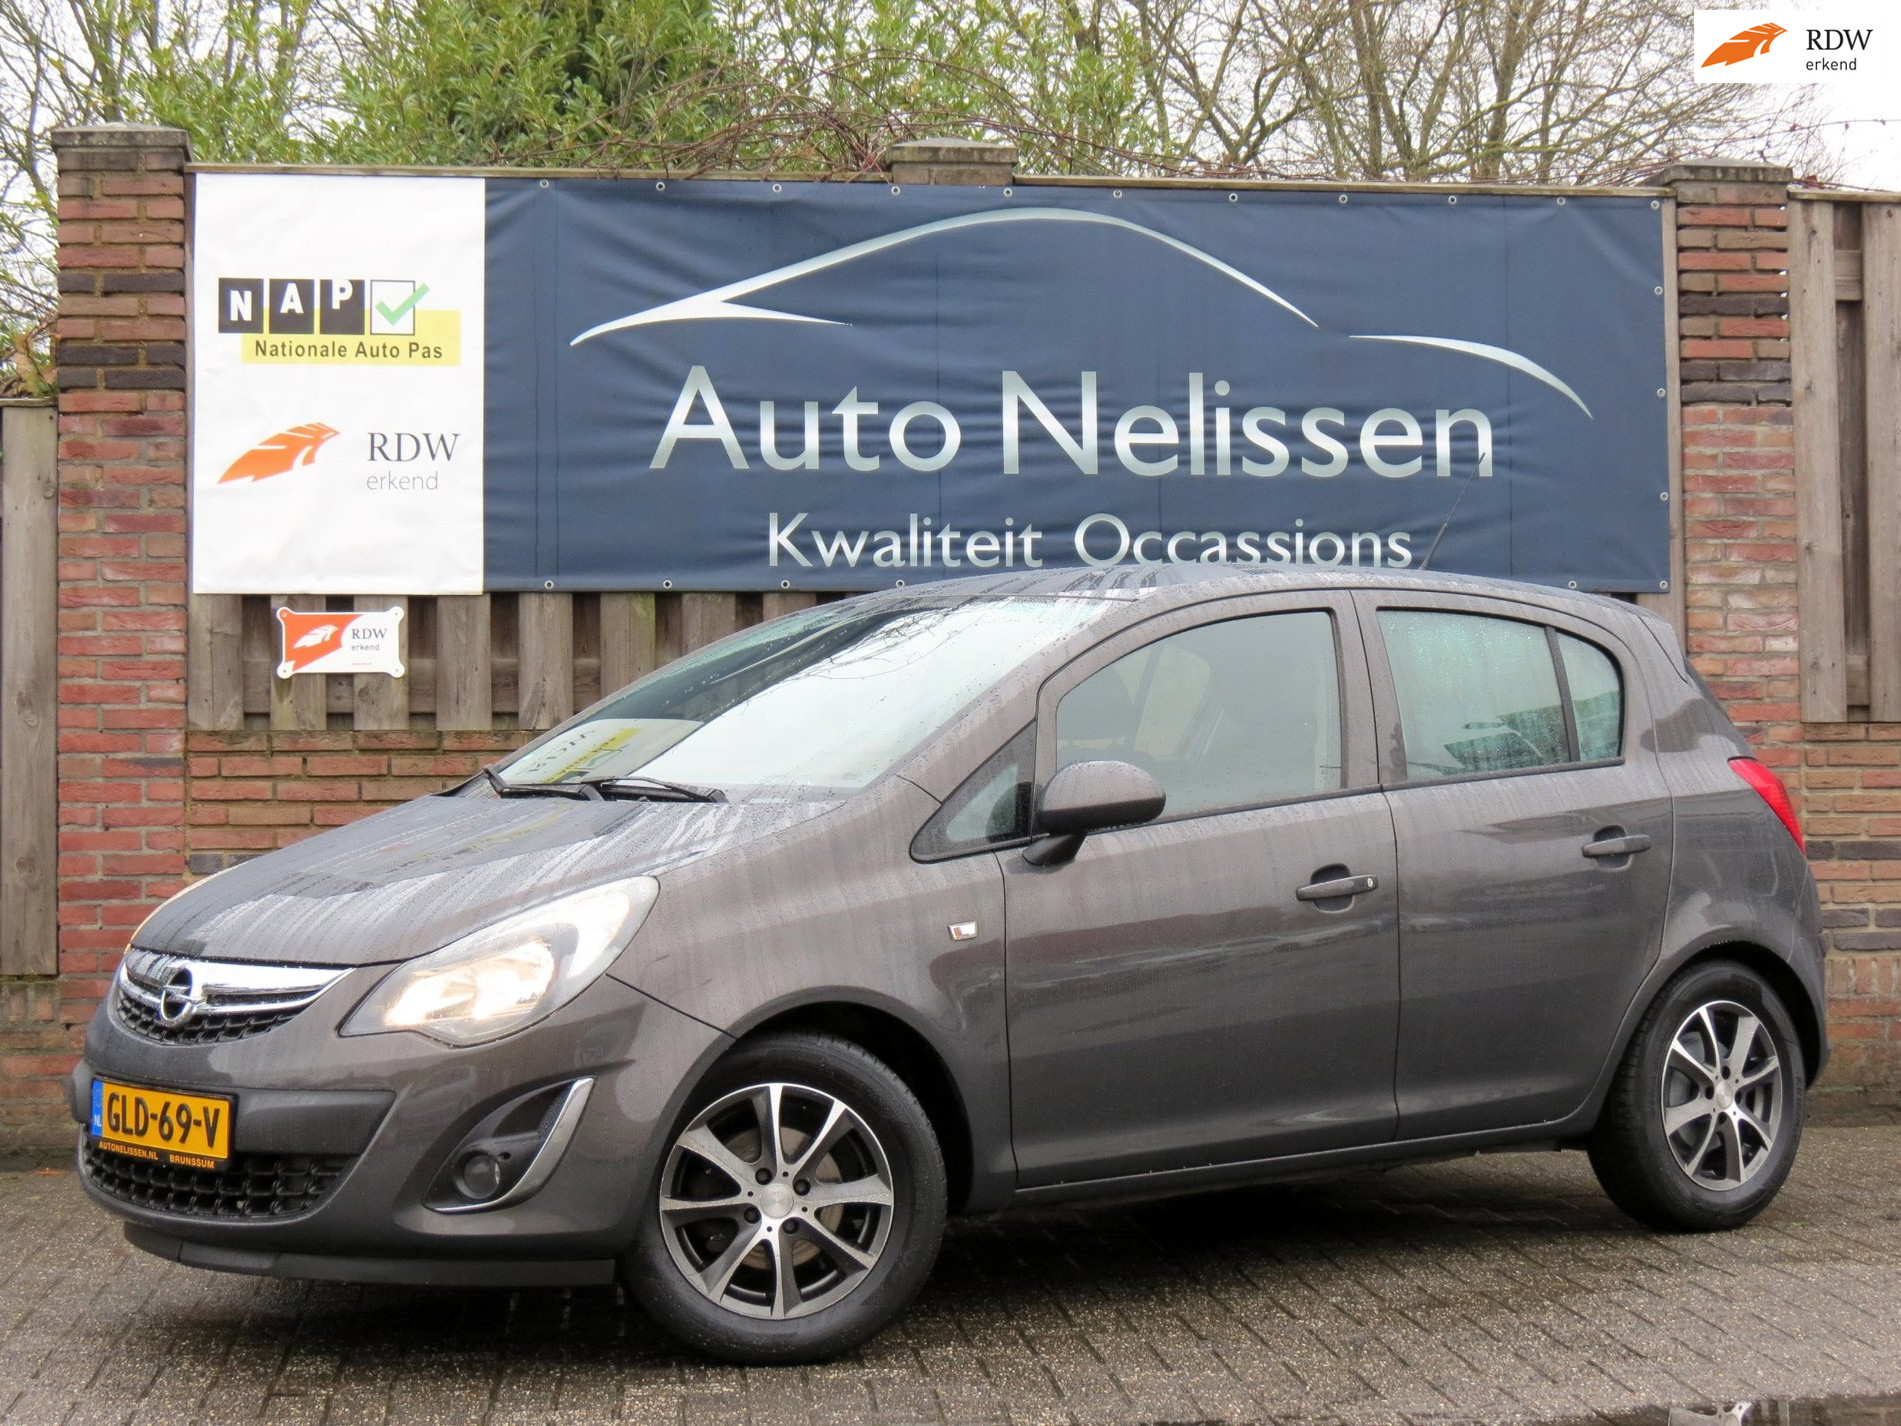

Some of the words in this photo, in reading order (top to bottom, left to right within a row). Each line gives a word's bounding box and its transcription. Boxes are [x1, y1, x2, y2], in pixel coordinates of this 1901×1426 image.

[229, 278, 353, 321] NAP
[255, 340, 347, 357] Nationale
[355, 341, 400, 358] Auto
[408, 341, 443, 359] Pas
[649, 365, 961, 472] Auto
[1002, 370, 1493, 477] Nelissen
[367, 432, 461, 462] RDW
[366, 470, 438, 490] erkend
[769, 512, 1043, 568] Kwaliteit
[1074, 512, 1412, 568] Occassions
[350, 643, 380, 651] erkend
[351, 628, 387, 640] RDW
[107, 1092, 220, 1149] GLD-69-V
[99, 1140, 159, 1161] AUTONELISSEN.NL
[169, 1154, 215, 1169] BRUNSSUM
